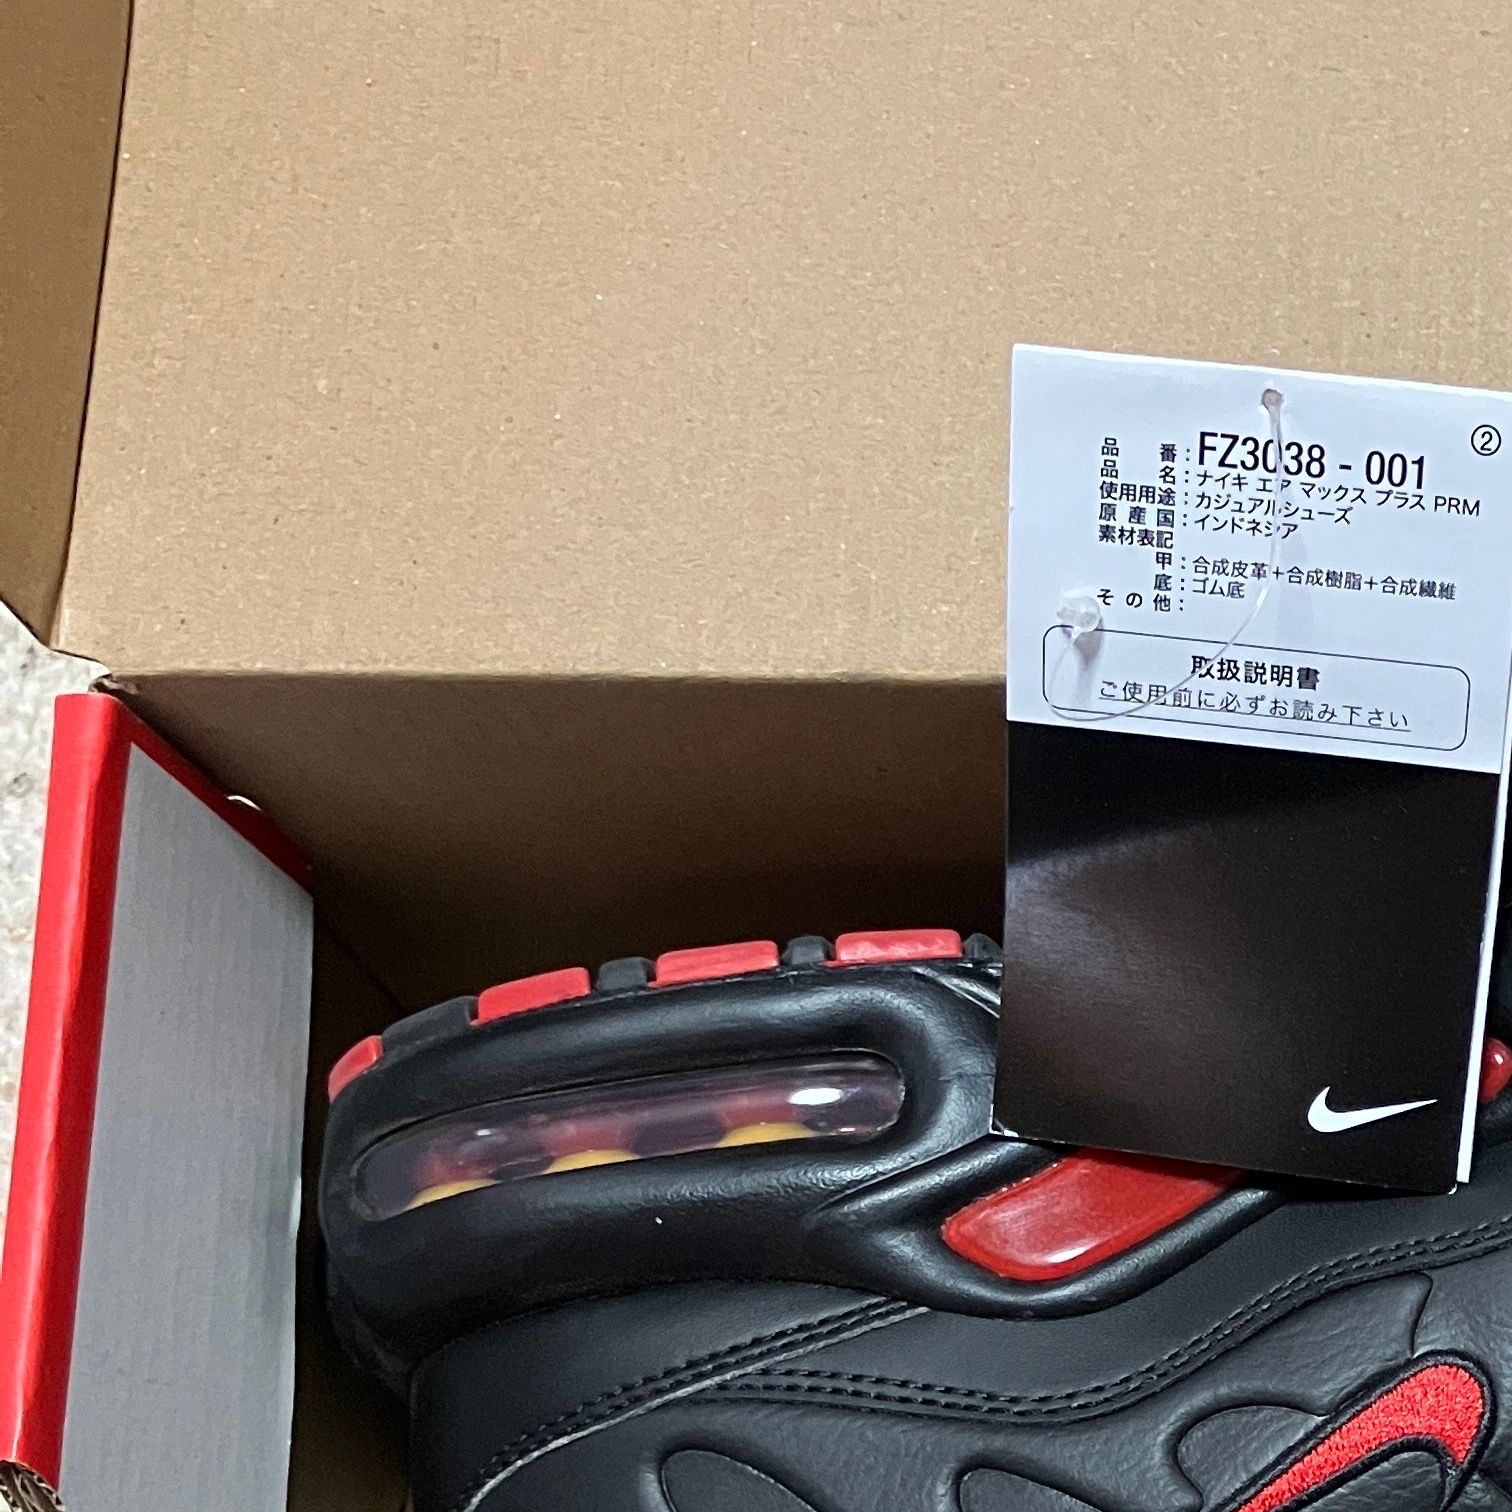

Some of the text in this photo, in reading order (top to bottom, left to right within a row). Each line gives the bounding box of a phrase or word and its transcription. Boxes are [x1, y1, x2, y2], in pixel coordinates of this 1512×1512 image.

[1198, 431, 1326, 478] FZ3038
[1365, 450, 1425, 489] 001
[1196, 470, 1249, 491] ナイキ
[1299, 481, 1367, 504] マックス
[1375, 489, 1426, 511] プラス
[1434, 496, 1481, 517] PRM
[1099, 524, 1174, 549] 素材表記
[1194, 514, 1299, 540] インドネシア
[1192, 577, 1246, 599] ゴム底
[1191, 655, 1321, 691] 取扱説明書
[1099, 680, 1410, 728] ご使用前に必ずお読み下さい
